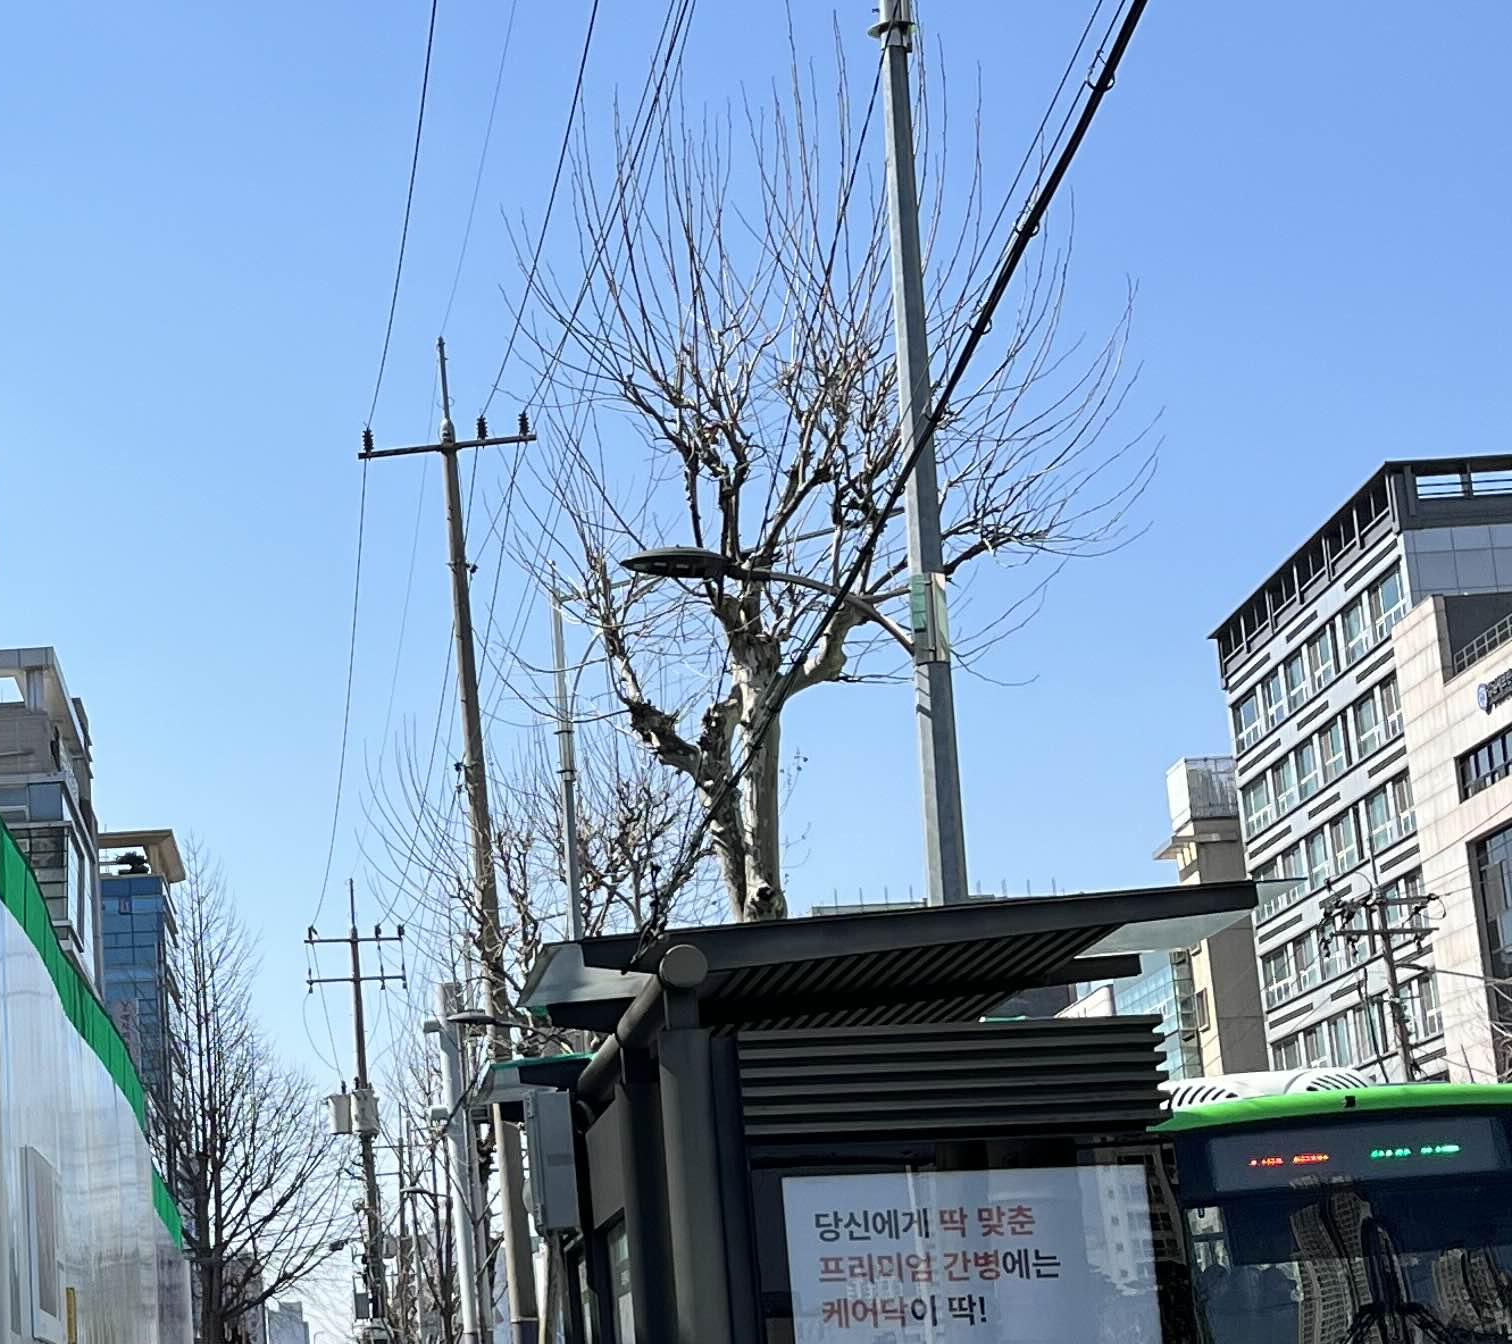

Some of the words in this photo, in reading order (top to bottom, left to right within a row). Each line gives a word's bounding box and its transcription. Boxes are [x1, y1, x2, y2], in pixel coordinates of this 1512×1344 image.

[814, 1208, 930, 1242] 당신에게
[938, 1206, 969, 1238] 딱
[977, 1204, 1037, 1237] 맞춘
[818, 1253, 933, 1285] 프리미엄
[943, 1247, 1061, 1283] 간병에는
[822, 1294, 938, 1330] 케어닥이
[948, 1295, 988, 1327] 딱!
